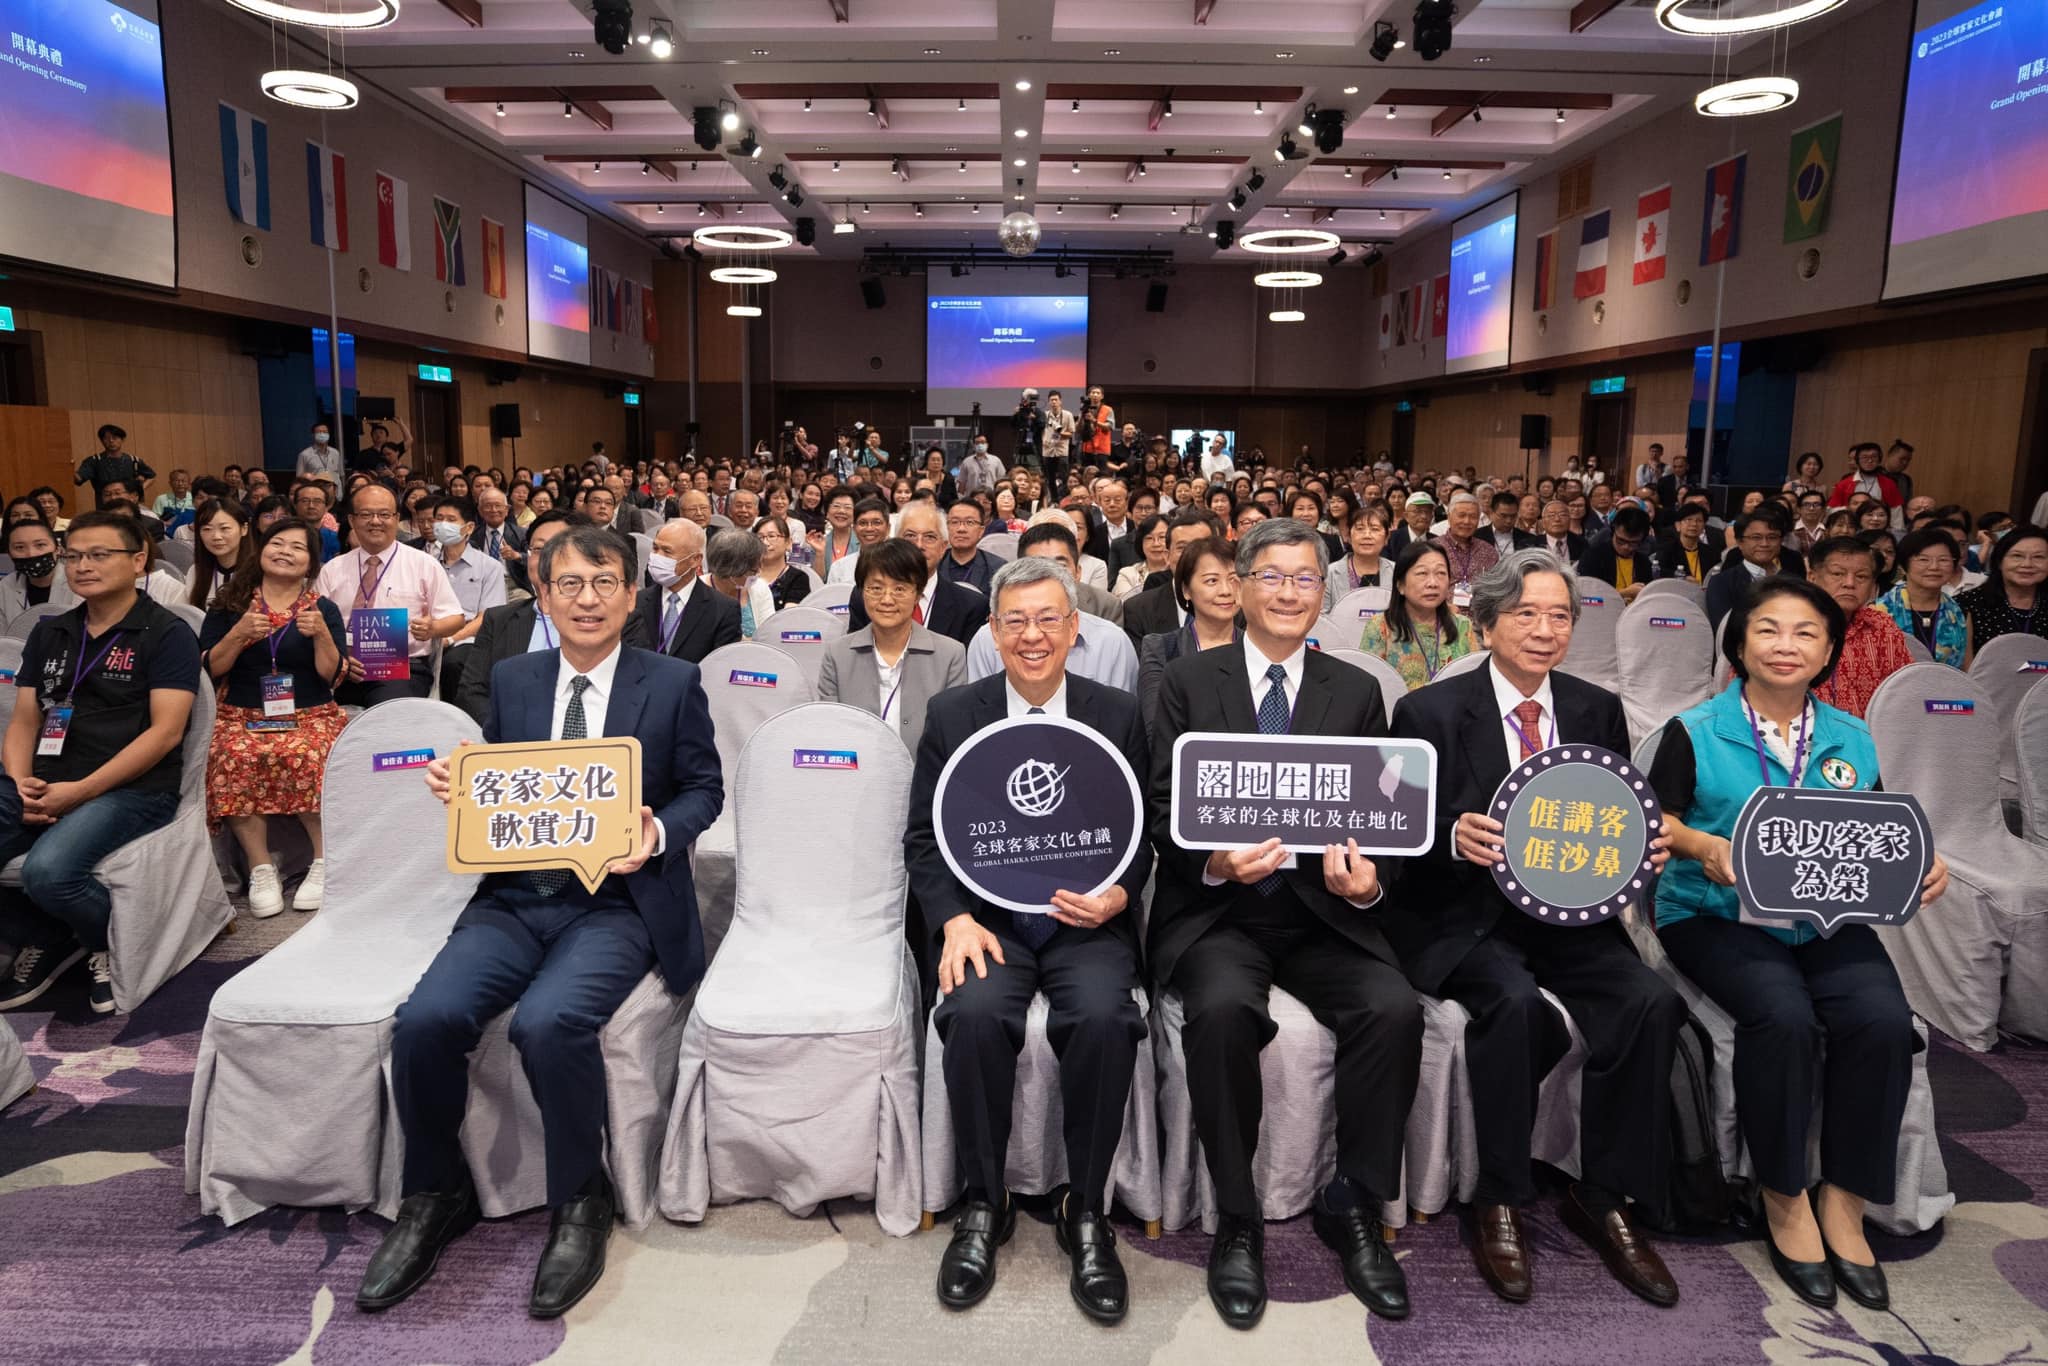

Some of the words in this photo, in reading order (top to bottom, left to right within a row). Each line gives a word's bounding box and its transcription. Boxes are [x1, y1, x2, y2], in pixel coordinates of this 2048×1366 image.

[11, 31, 63, 67] 開幕典禮
[15, 56, 49, 79] Opening
[50, 70, 88, 93] Ceremony
[2018, 57, 2048, 84] 開幕
[1990, 92, 2015, 110] Grand
[473, 764, 617, 806] 客家文化
[1199, 764, 1349, 801] 落地生根
[488, 809, 596, 849] 軟實力
[968, 820, 1007, 837] 2023
[1197, 805, 1408, 831] 客家的全球化及在地化
[972, 827, 1112, 857] 全球客家文化會議
[974, 859, 1002, 868] GLOBAL
[1003, 857, 1030, 865] HAKKA
[1030, 852, 1064, 862] CULTURE
[1065, 847, 1113, 858] CONFERENCE
[1758, 817, 1911, 862] 我以客家
[1791, 861, 1870, 902] 為榮
